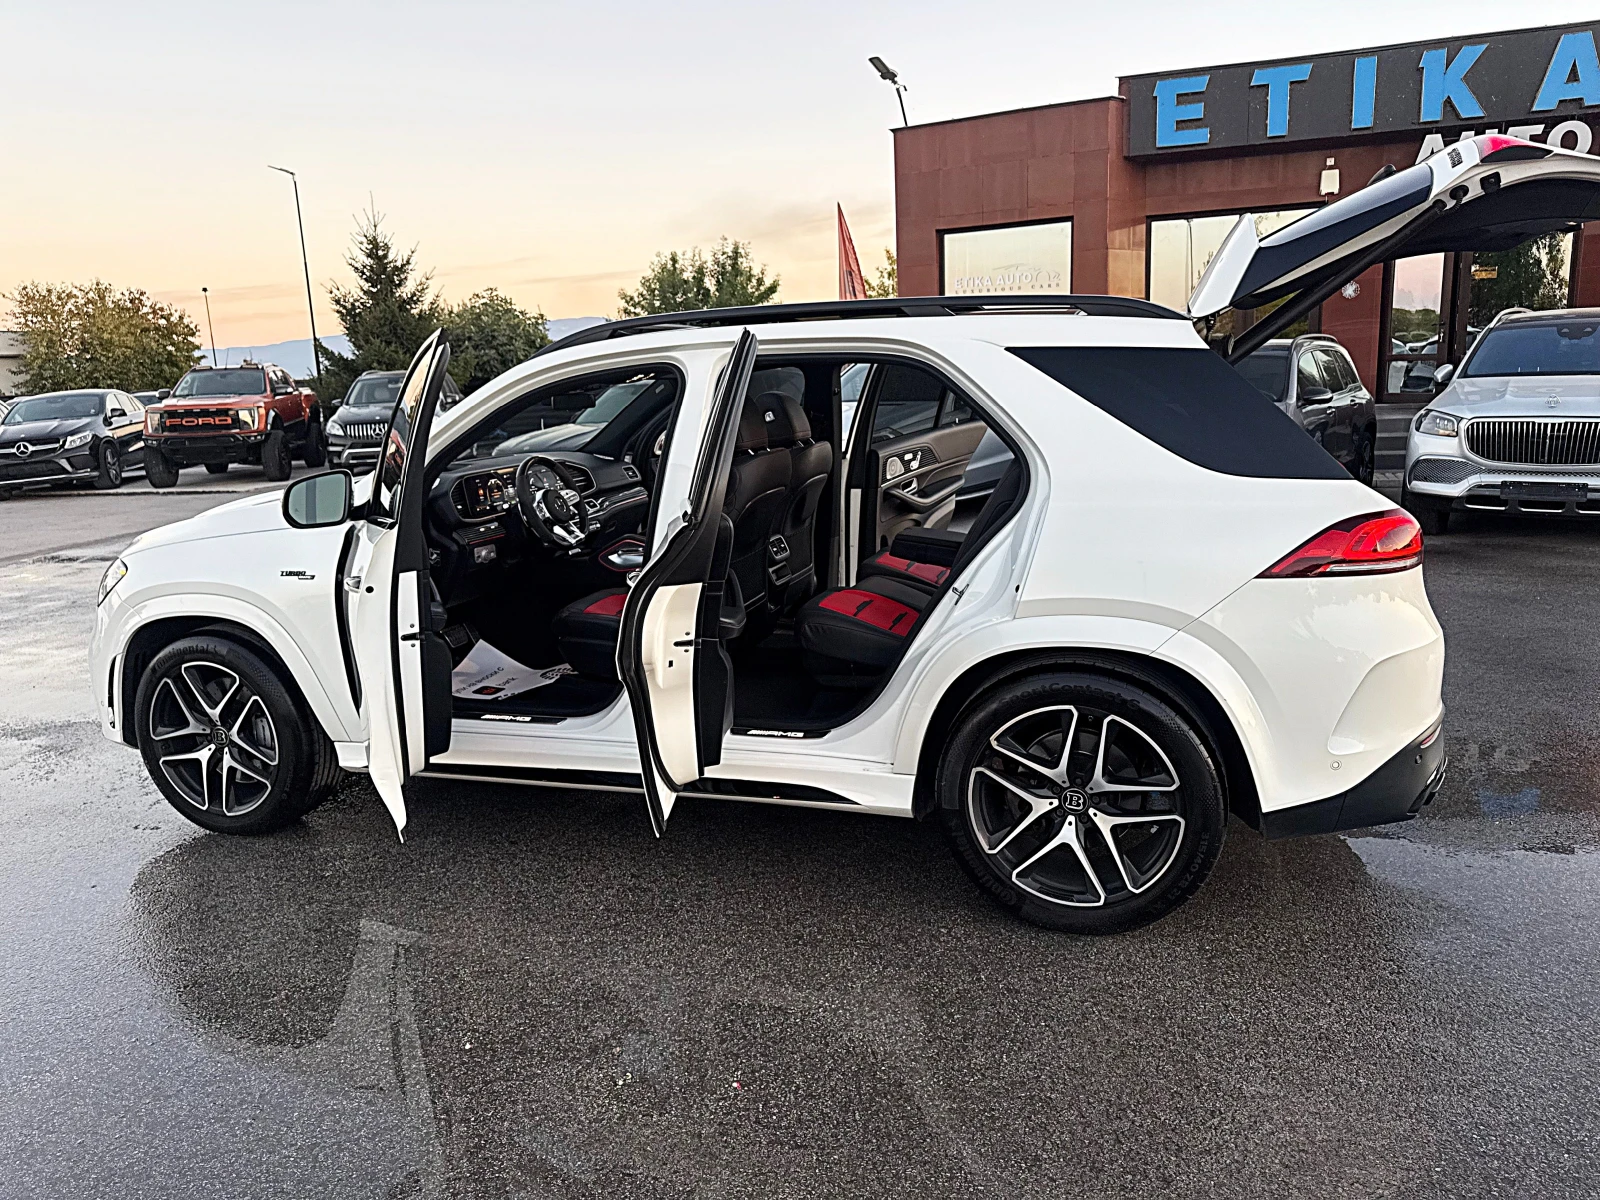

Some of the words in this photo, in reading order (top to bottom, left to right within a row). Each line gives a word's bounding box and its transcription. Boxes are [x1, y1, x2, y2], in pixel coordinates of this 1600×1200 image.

[1153, 31, 1600, 148] ETIKA
[955, 276, 993, 289] ETIKA
[996, 272, 1033, 285] AUTO
[955, 285, 1021, 295] LUXURIOUS
[1031, 282, 1060, 290] CARS
[165, 416, 232, 427] FORD
[213, 730, 226, 744] B
[767, 730, 804, 738] AMG
[1066, 792, 1084, 810] B
